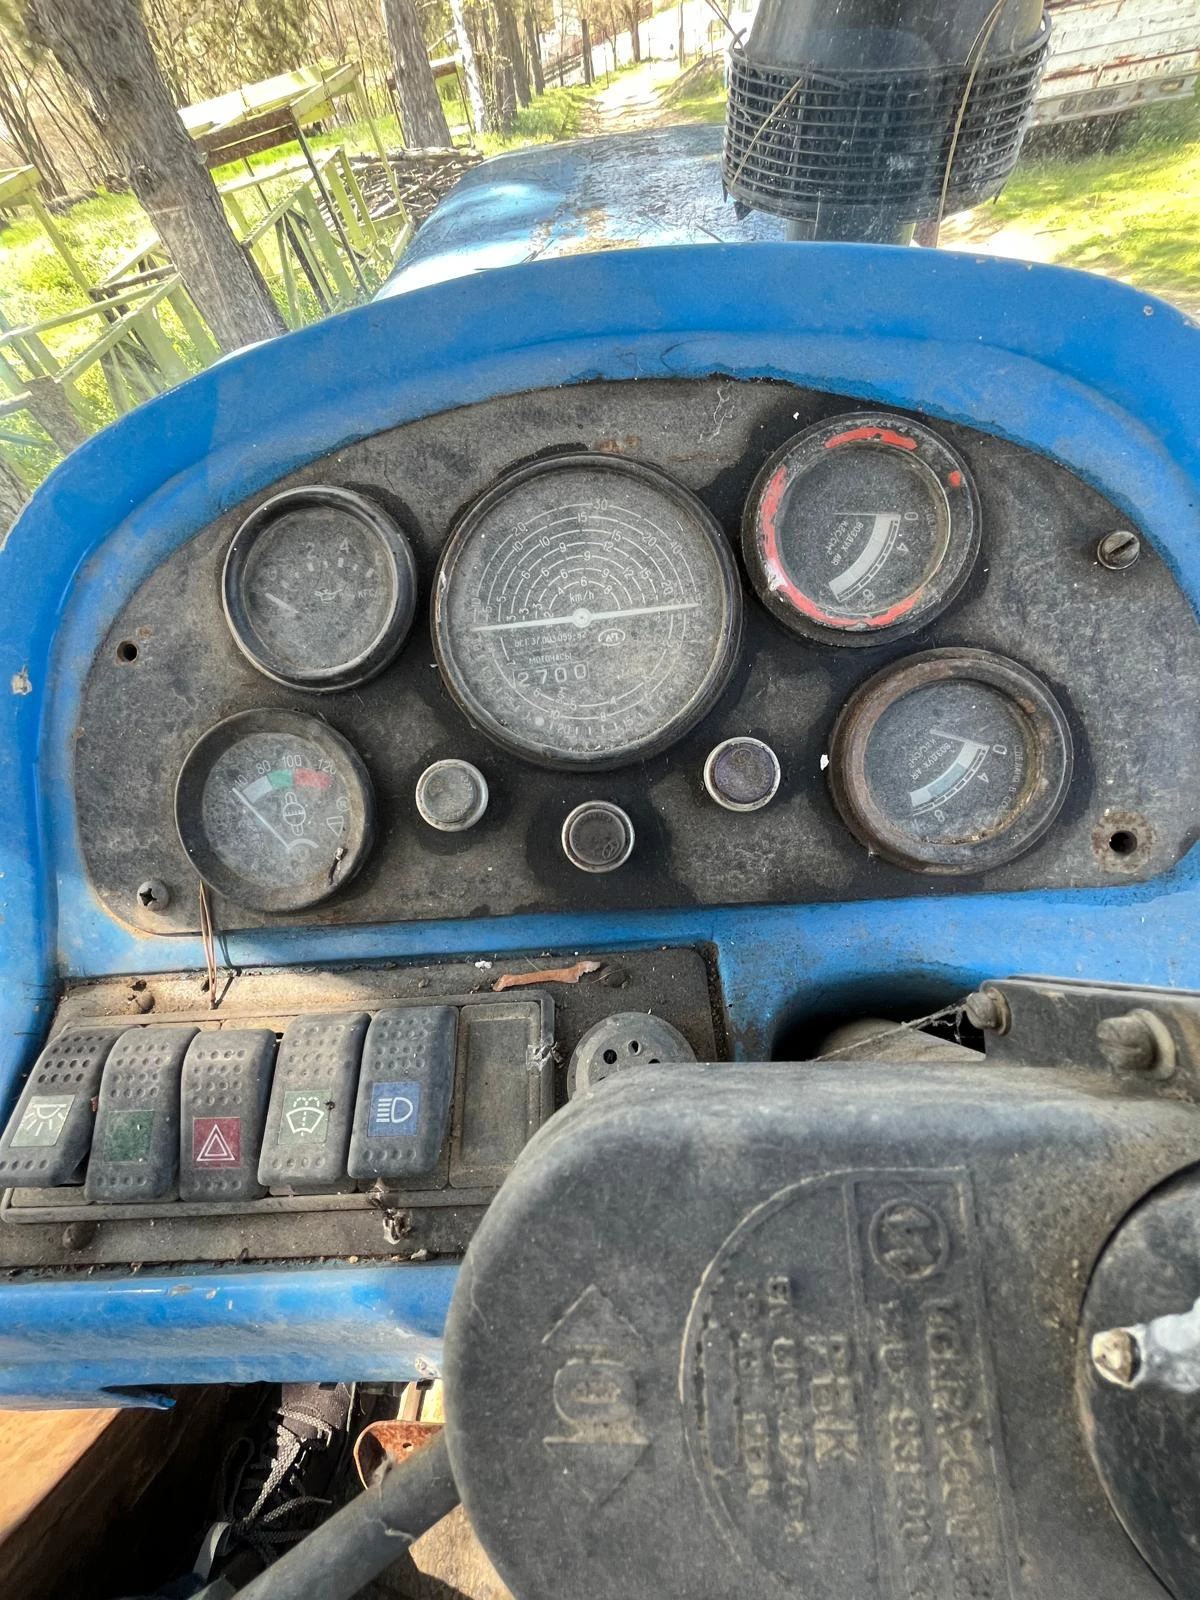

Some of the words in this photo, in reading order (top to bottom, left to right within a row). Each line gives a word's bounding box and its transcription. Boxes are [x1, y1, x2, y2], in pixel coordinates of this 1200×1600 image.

[577, 512, 587, 523] 15
[512, 522, 527, 537] 20
[610, 529, 622, 541] 15
[339, 537, 350, 554] 4
[539, 537, 551, 548] 10
[642, 533, 657, 547] 20
[512, 541, 523, 553] 10
[558, 542, 568, 553] 9
[603, 541, 614, 552] 12
[583, 550, 592, 561] 9
[521, 569, 531, 580] 6
[541, 567, 550, 577] 6
[560, 568, 569, 579] 6
[601, 568, 610, 579] 9
[640, 568, 651, 580] 15
[580, 577, 588, 586] 6
[557, 586, 565, 596] 4
[661, 580, 674, 596] 20
[569, 591, 595, 602] km/h
[517, 664, 587, 687] 2700
[281, 754, 303, 768] 100
[255, 759, 272, 775] 80
